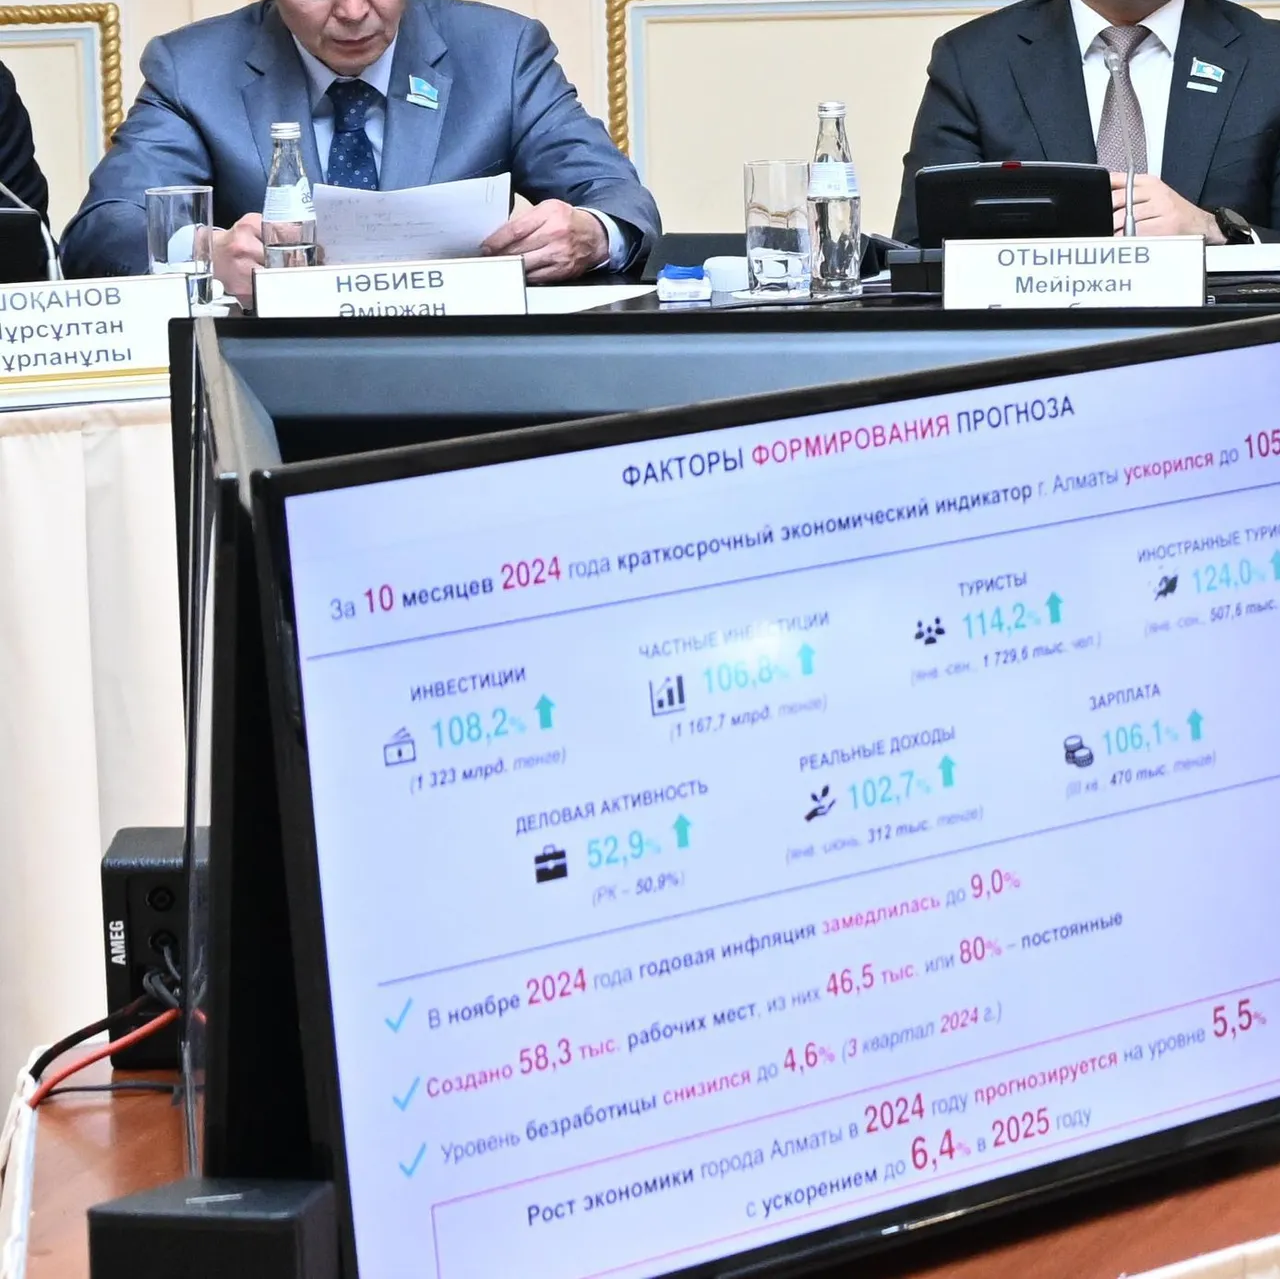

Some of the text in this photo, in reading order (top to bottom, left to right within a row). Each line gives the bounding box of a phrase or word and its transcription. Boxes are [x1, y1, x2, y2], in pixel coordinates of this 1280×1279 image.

[997, 247, 1150, 267] ОТЫНШИЕВ
[336, 271, 444, 293] НӘБИЕВ
[1015, 275, 1132, 296] Мейіржан
[0, 320, 124, 344] ұрсұлтан
[2, 348, 132, 372] ұрланұлы
[622, 395, 1075, 487] ФАКТОРЫ ФОРМИРОВАНИЯ ПРОГНОЗА
[330, 598, 356, 621] За
[364, 584, 394, 613] 10
[402, 577, 493, 608] месяцев
[501, 556, 561, 590] 2024
[568, 557, 610, 579] года
[617, 526, 773, 572] краткосрочный
[781, 499, 928, 541] экономический
[936, 482, 1031, 514] индикатор
[1053, 469, 1118, 494] Алматы
[1123, 450, 1214, 485] ускорился
[1219, 448, 1240, 468] до
[1137, 530, 1241, 563] ИНОСТРАННЫЕ
[959, 571, 1027, 598] ТУРИСТЫ
[639, 630, 718, 659] ЧАСТНЫЕ
[410, 667, 526, 702] ИНВЕСТИЦИИ
[1089, 683, 1161, 711] ЗАРПЛАТА
[799, 726, 956, 772] РЕАЛЬНЫЕ ДОХОДЫ
[462, 757, 508, 782] млрд.
[516, 780, 708, 836] ДЕЛОВАЯ АКТИВНОСТЬ
[111, 920, 126, 965] AMEG
[427, 868, 1021, 1030] В ноябре 2024 года годовая инфляция замедлилась до 9,0%
[426, 1063, 513, 1099] Создано
[519, 1038, 572, 1077] 58,3
[579, 1039, 620, 1061] тыс.
[627, 1016, 707, 1053] рабочих
[767, 996, 786, 1013] из
[791, 987, 821, 1008] них
[826, 964, 874, 998] 46,5
[881, 963, 919, 985] тыс.
[925, 953, 955, 975] или
[959, 936, 1002, 965] 80%
[1021, 911, 1123, 950] постоянные
[441, 1132, 520, 1166] Уровень
[526, 1093, 657, 1142] безработицы
[663, 1069, 751, 1106] снизился
[756, 1062, 778, 1084] до
[784, 1042, 835, 1075] 4,6%
[862, 1022, 935, 1055] квартал
[940, 1006, 979, 1035] 2024
[527, 998, 1267, 1226] Рост экономики города Алматы в 2024 году прогнозируется на уровне 5,5%
[746, 1107, 1092, 1218] с ускорением до 6,4% в 2025 году
